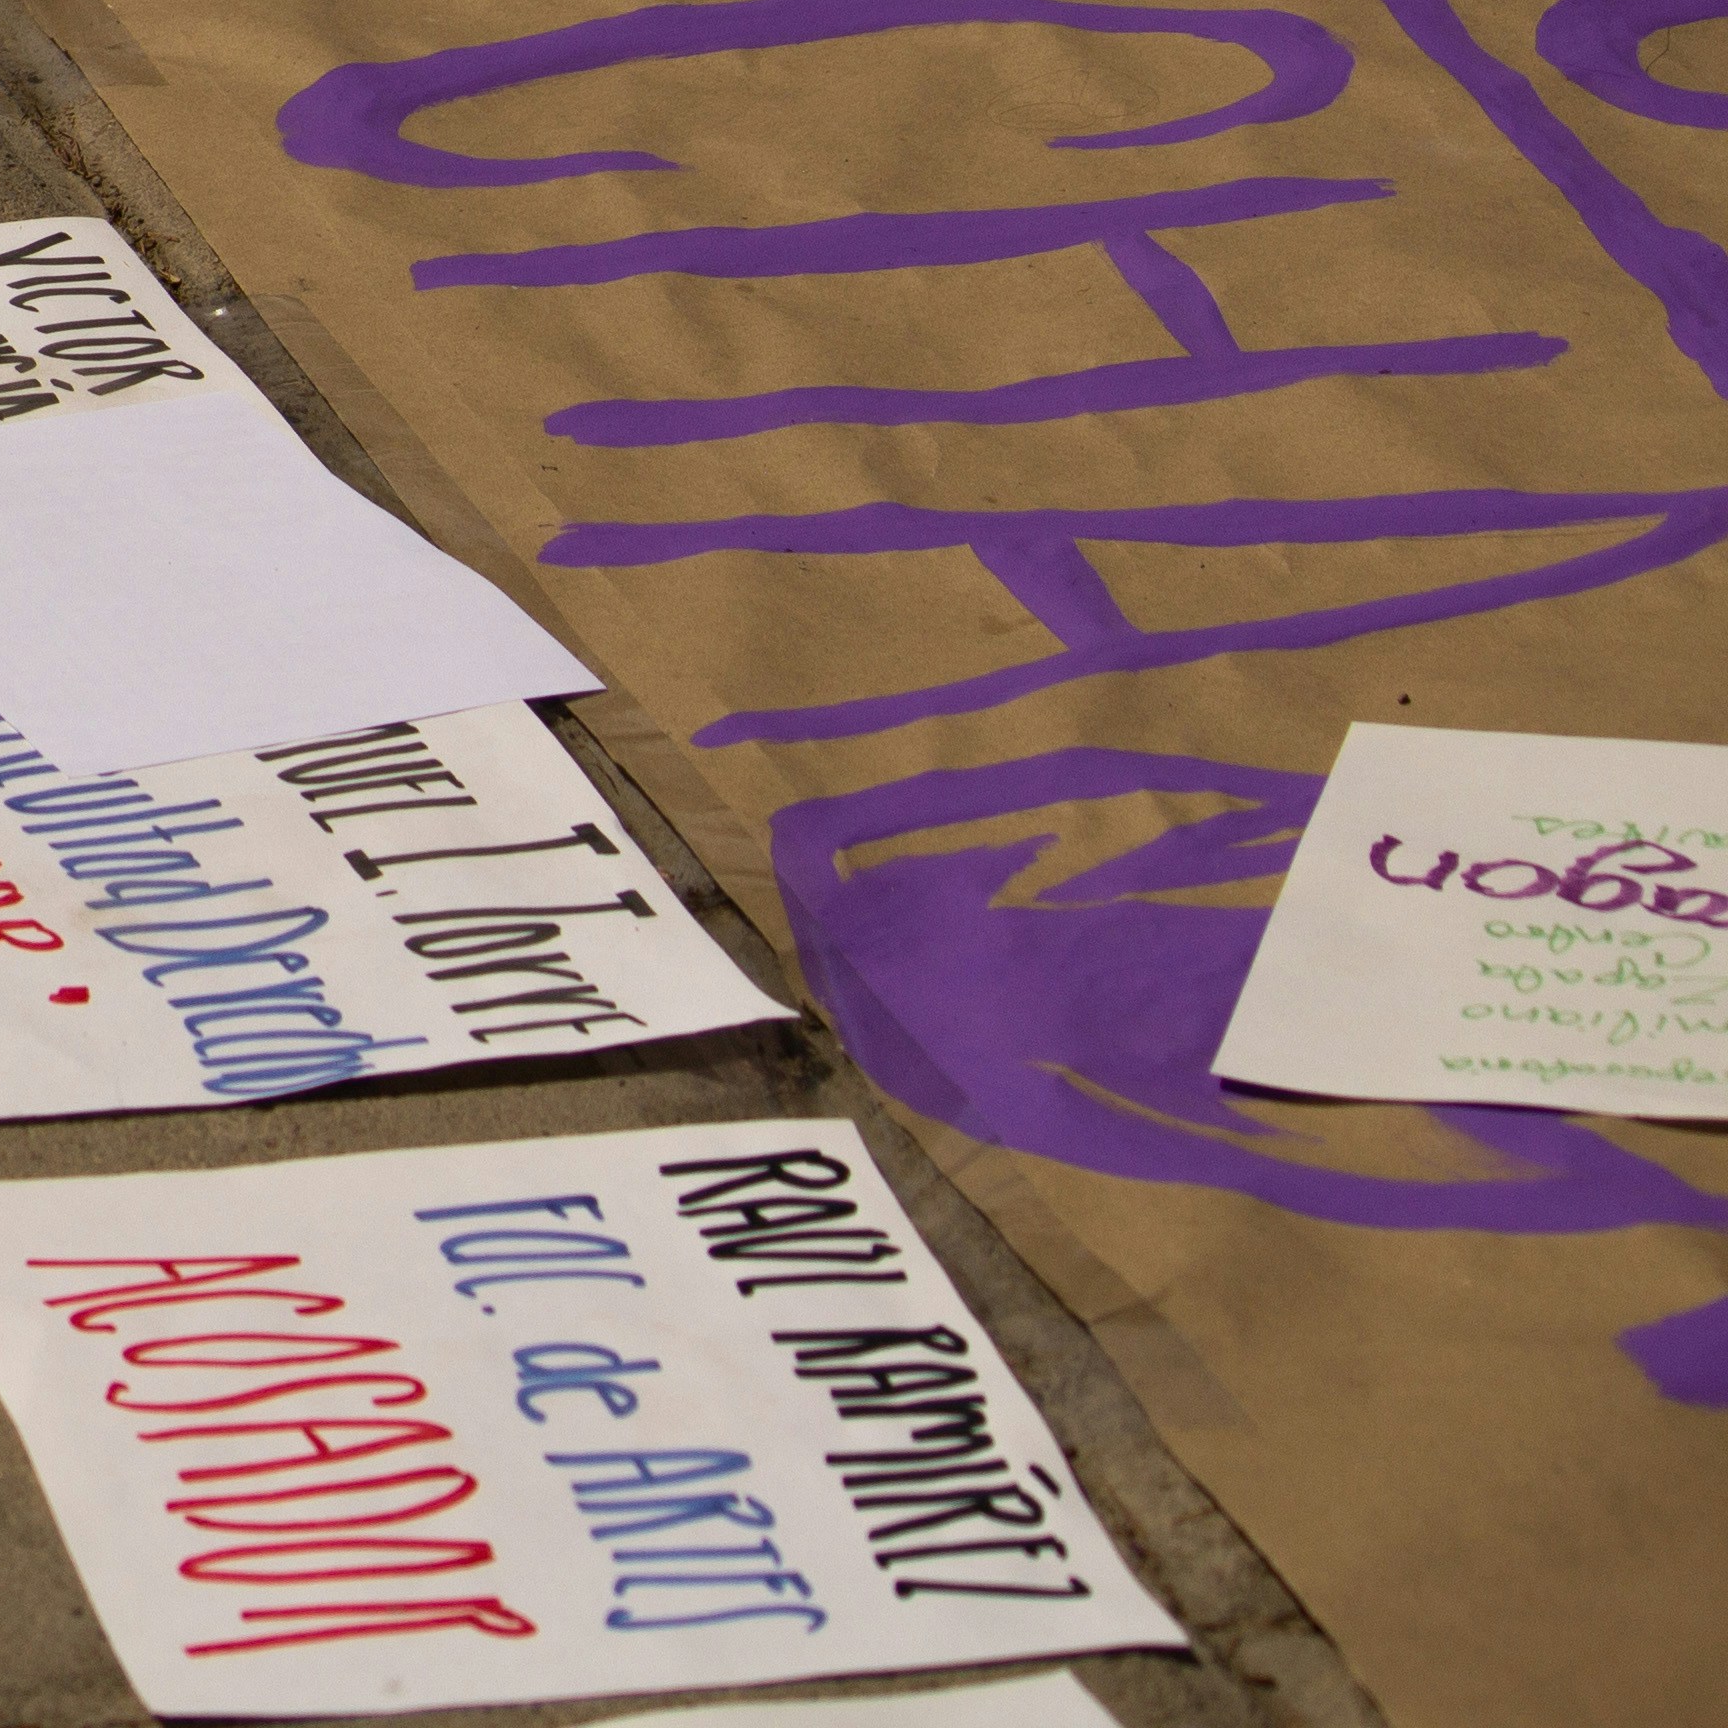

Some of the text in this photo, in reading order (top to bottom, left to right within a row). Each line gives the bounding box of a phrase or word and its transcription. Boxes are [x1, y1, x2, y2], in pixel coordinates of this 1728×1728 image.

[27, 1256, 537, 1659] ACOSADOR
[511, 1342, 827, 1635] de ARTES
[772, 1325, 1091, 1601] RAMÍREZ
